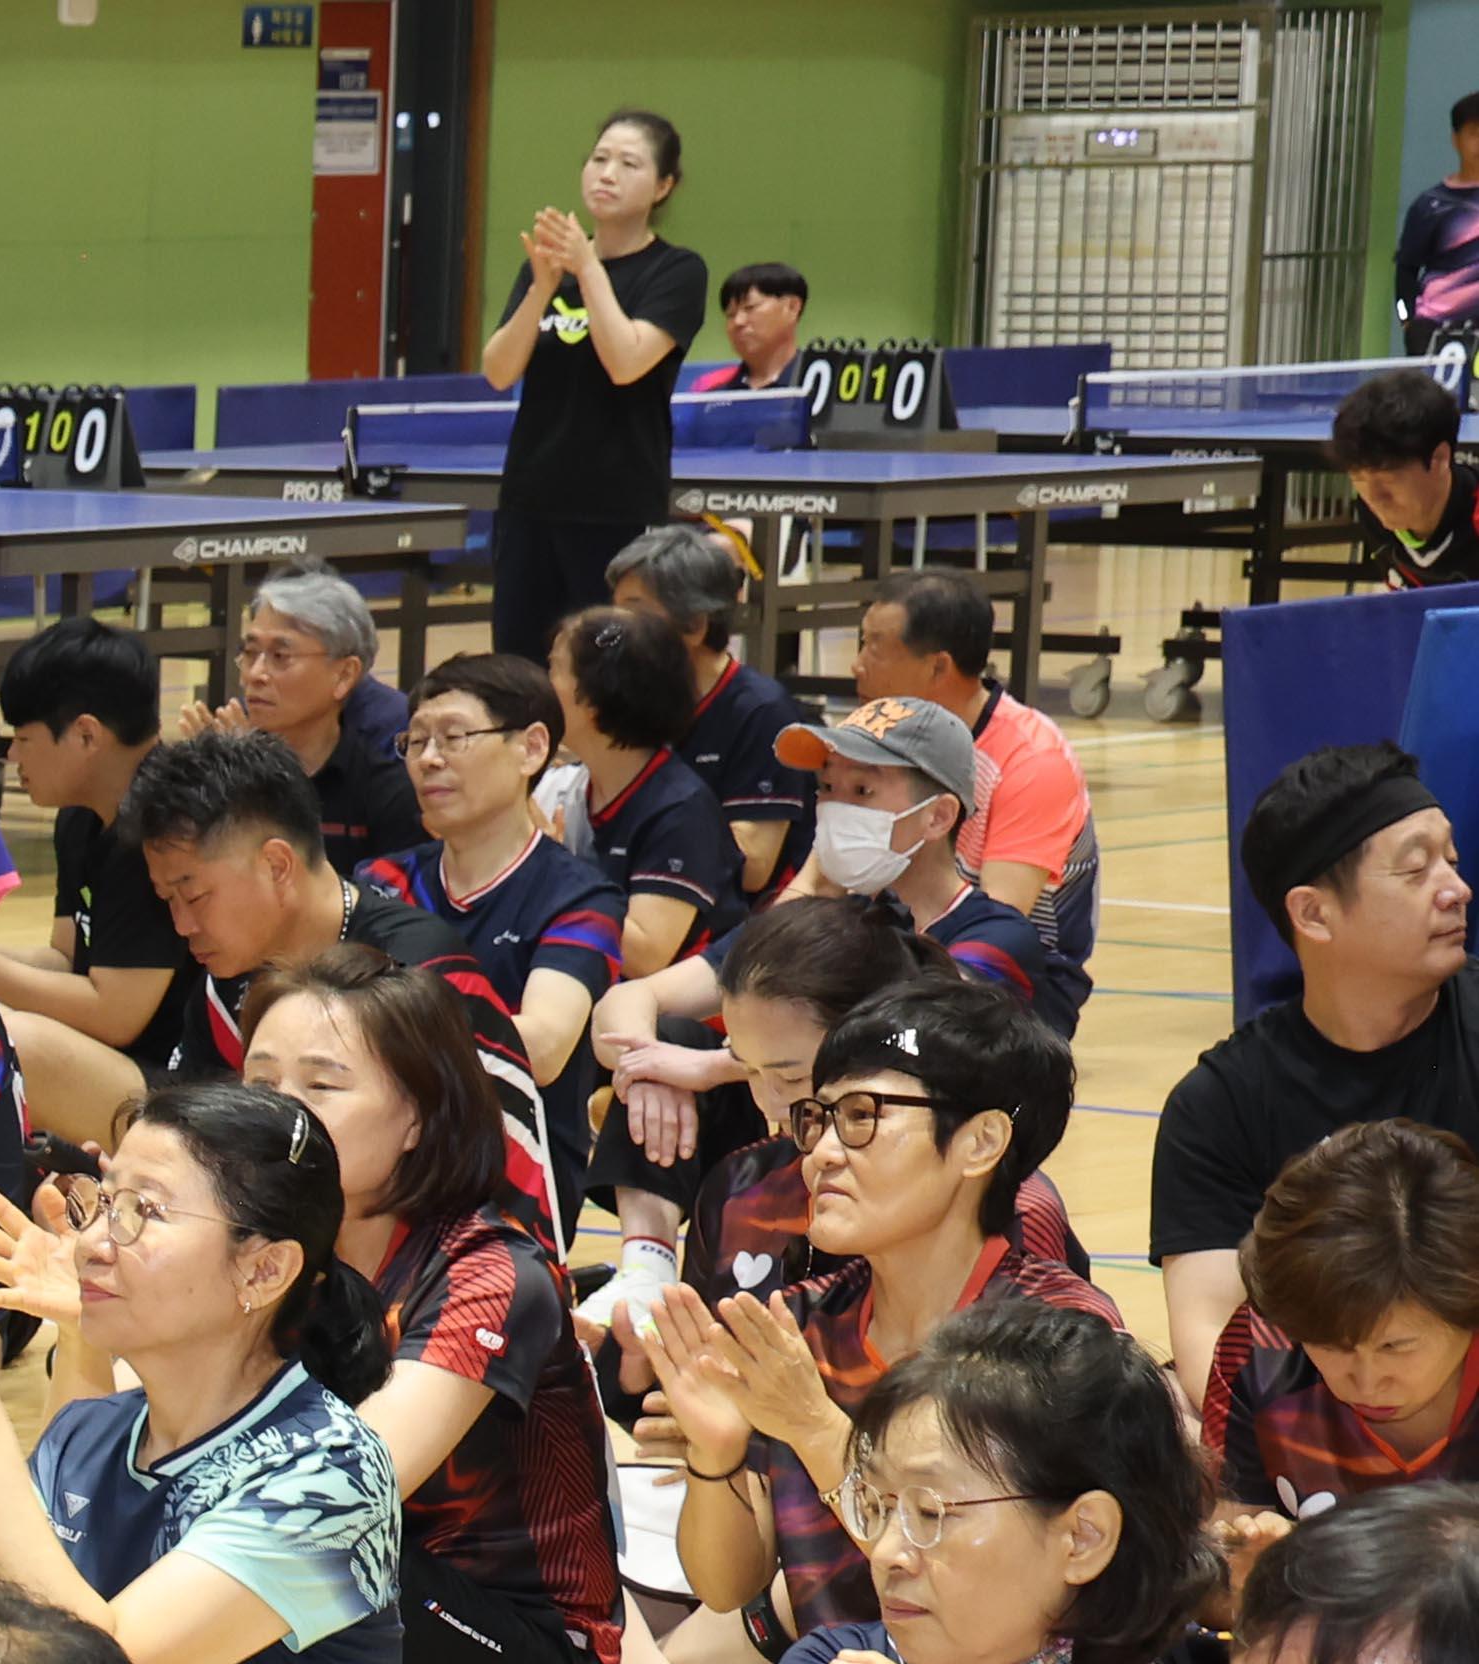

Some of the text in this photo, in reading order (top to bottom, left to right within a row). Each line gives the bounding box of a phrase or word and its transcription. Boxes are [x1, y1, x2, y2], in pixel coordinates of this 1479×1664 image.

[839, 363, 861, 401] 0
[871, 363, 889, 401] 1
[892, 360, 926, 421] 0
[25, 411, 41, 452] 1
[49, 410, 74, 452] 0
[74, 407, 108, 474] 0
[283, 481, 344, 503] PRO 9S
[706, 492, 837, 514] CHAMPION
[1038, 483, 1129, 504] CHAMPION
[200, 535, 308, 559] CHAMPION
